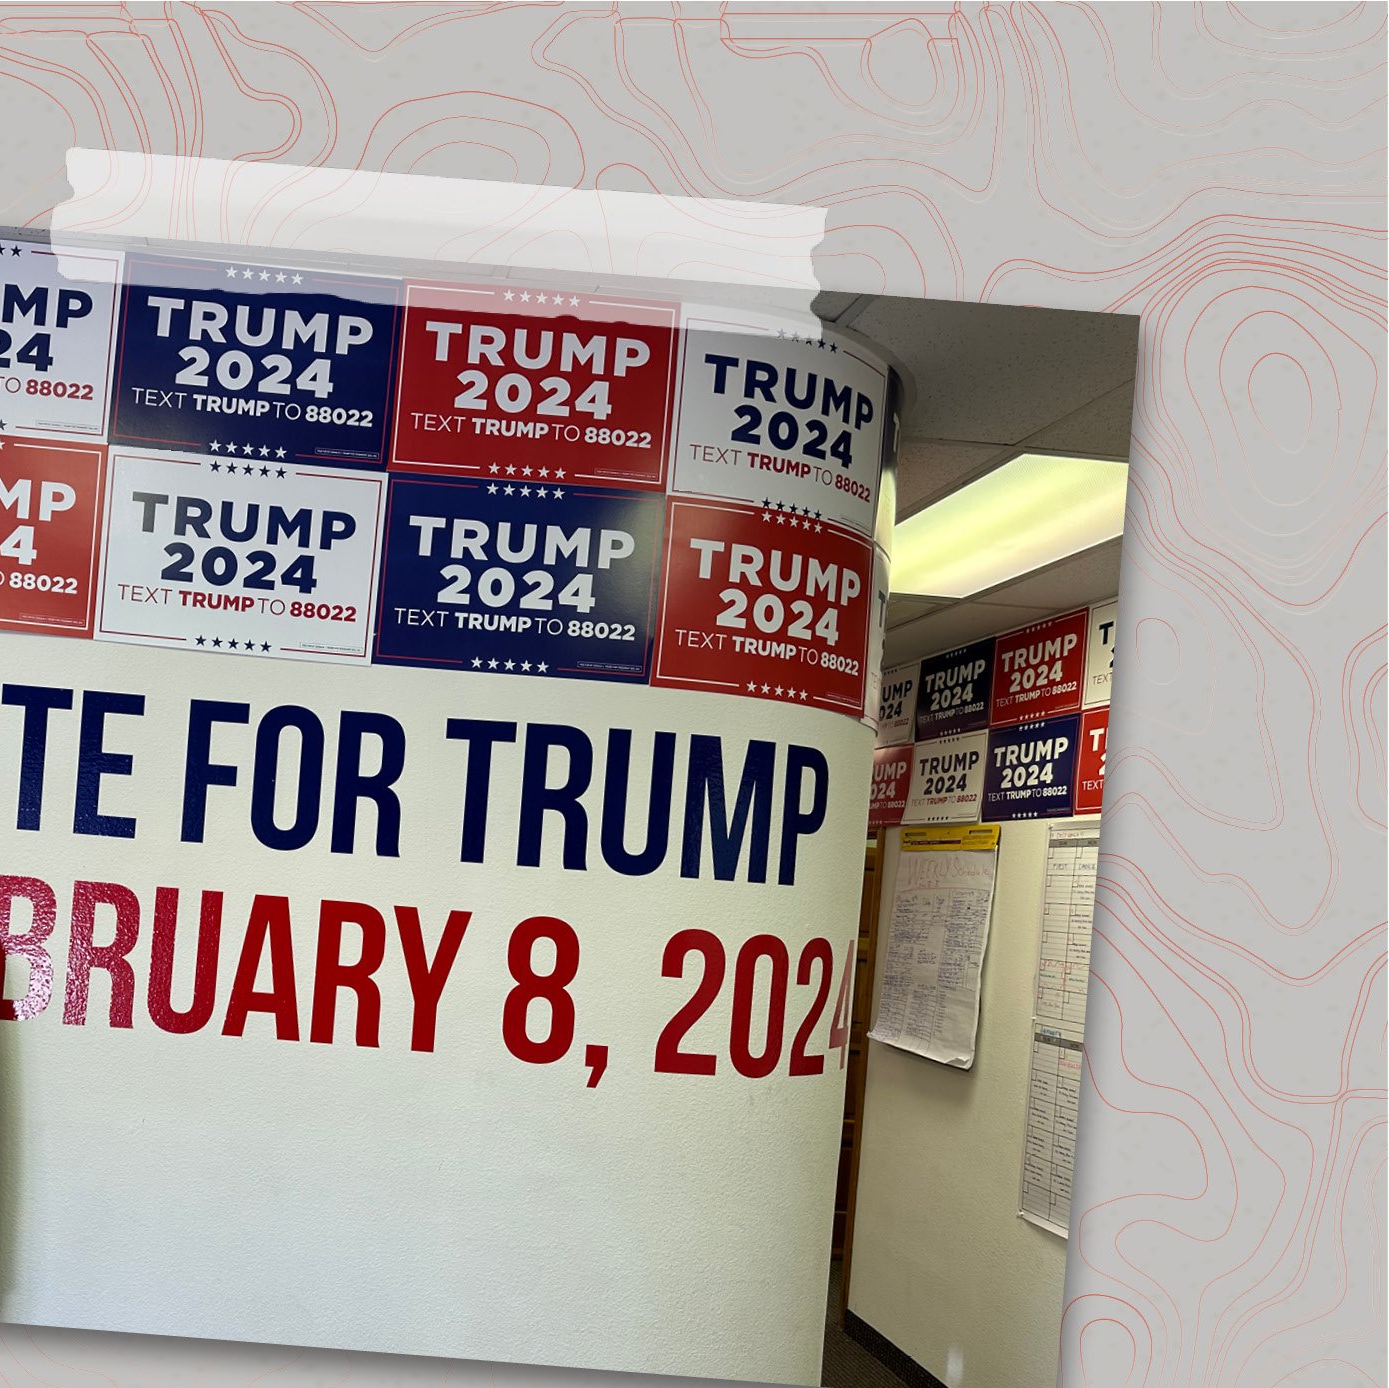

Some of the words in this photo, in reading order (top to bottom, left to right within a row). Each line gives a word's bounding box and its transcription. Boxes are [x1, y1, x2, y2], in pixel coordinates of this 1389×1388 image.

[146, 295, 374, 356] TRUMP
[425, 321, 651, 378] TRUMP
[25, 377, 94, 401] 88022
[174, 345, 333, 399] 2024
[703, 352, 874, 430] TRUMP
[132, 387, 187, 410] TEXT
[192, 393, 270, 418] TRUMP
[273, 400, 301, 421] TO
[304, 406, 373, 428] 88022
[453, 370, 612, 421] 2024
[411, 412, 467, 433] TEXT
[472, 418, 549, 441] TRUMP
[552, 424, 580, 443] TO
[584, 428, 652, 450] 88022
[730, 404, 853, 469] 2024
[690, 443, 742, 466] TEXT
[747, 451, 811, 479] TRUMP
[812, 464, 832, 486] TO
[834, 474, 872, 503] 88022
[132, 491, 357, 551] TRUMP
[408, 514, 635, 570] TRUMP
[8, 571, 78, 595] 88022
[160, 541, 317, 594] 2024
[689, 537, 862, 608] TRUMP
[118, 583, 173, 605] TEXT
[178, 590, 256, 613] TRUMP
[258, 596, 286, 617] TO
[289, 600, 357, 623] 88022
[436, 564, 595, 613] 2024
[394, 606, 450, 628] TEXT
[454, 611, 533, 635] TRUMP
[535, 618, 563, 638] TO
[567, 621, 635, 642] 88022
[715, 588, 840, 646] 2024
[674, 628, 728, 651] TEXT
[731, 634, 797, 661] TRUMP
[798, 646, 818, 664] TO
[819, 649, 859, 678] 88022
[1001, 633, 1078, 673] TRUMP
[882, 680, 913, 702] UMP
[925, 659, 986, 693] TRUMP
[1009, 660, 1063, 693] 2024
[1015, 690, 1041, 703] TRUMP
[1052, 681, 1077, 695] 88022
[879, 701, 903, 722] 024
[930, 683, 973, 712] 2024
[935, 709, 956, 722] TRUMP
[873, 761, 907, 781] UMP
[919, 751, 980, 776] TRUMP
[994, 736, 1069, 767] TRUMP
[180, 698, 408, 859] FOR
[445, 717, 830, 887] TRUMP
[871, 781, 895, 800] 024
[924, 773, 967, 796] 2024
[1000, 762, 1054, 789] 2024
[1006, 789, 1032, 800] TRUMP
[1042, 786, 1067, 797] 88022
[1082, 780, 1103, 791] TEXT
[500, 916, 610, 1089] 8,
[654, 928, 855, 1079] 2024
